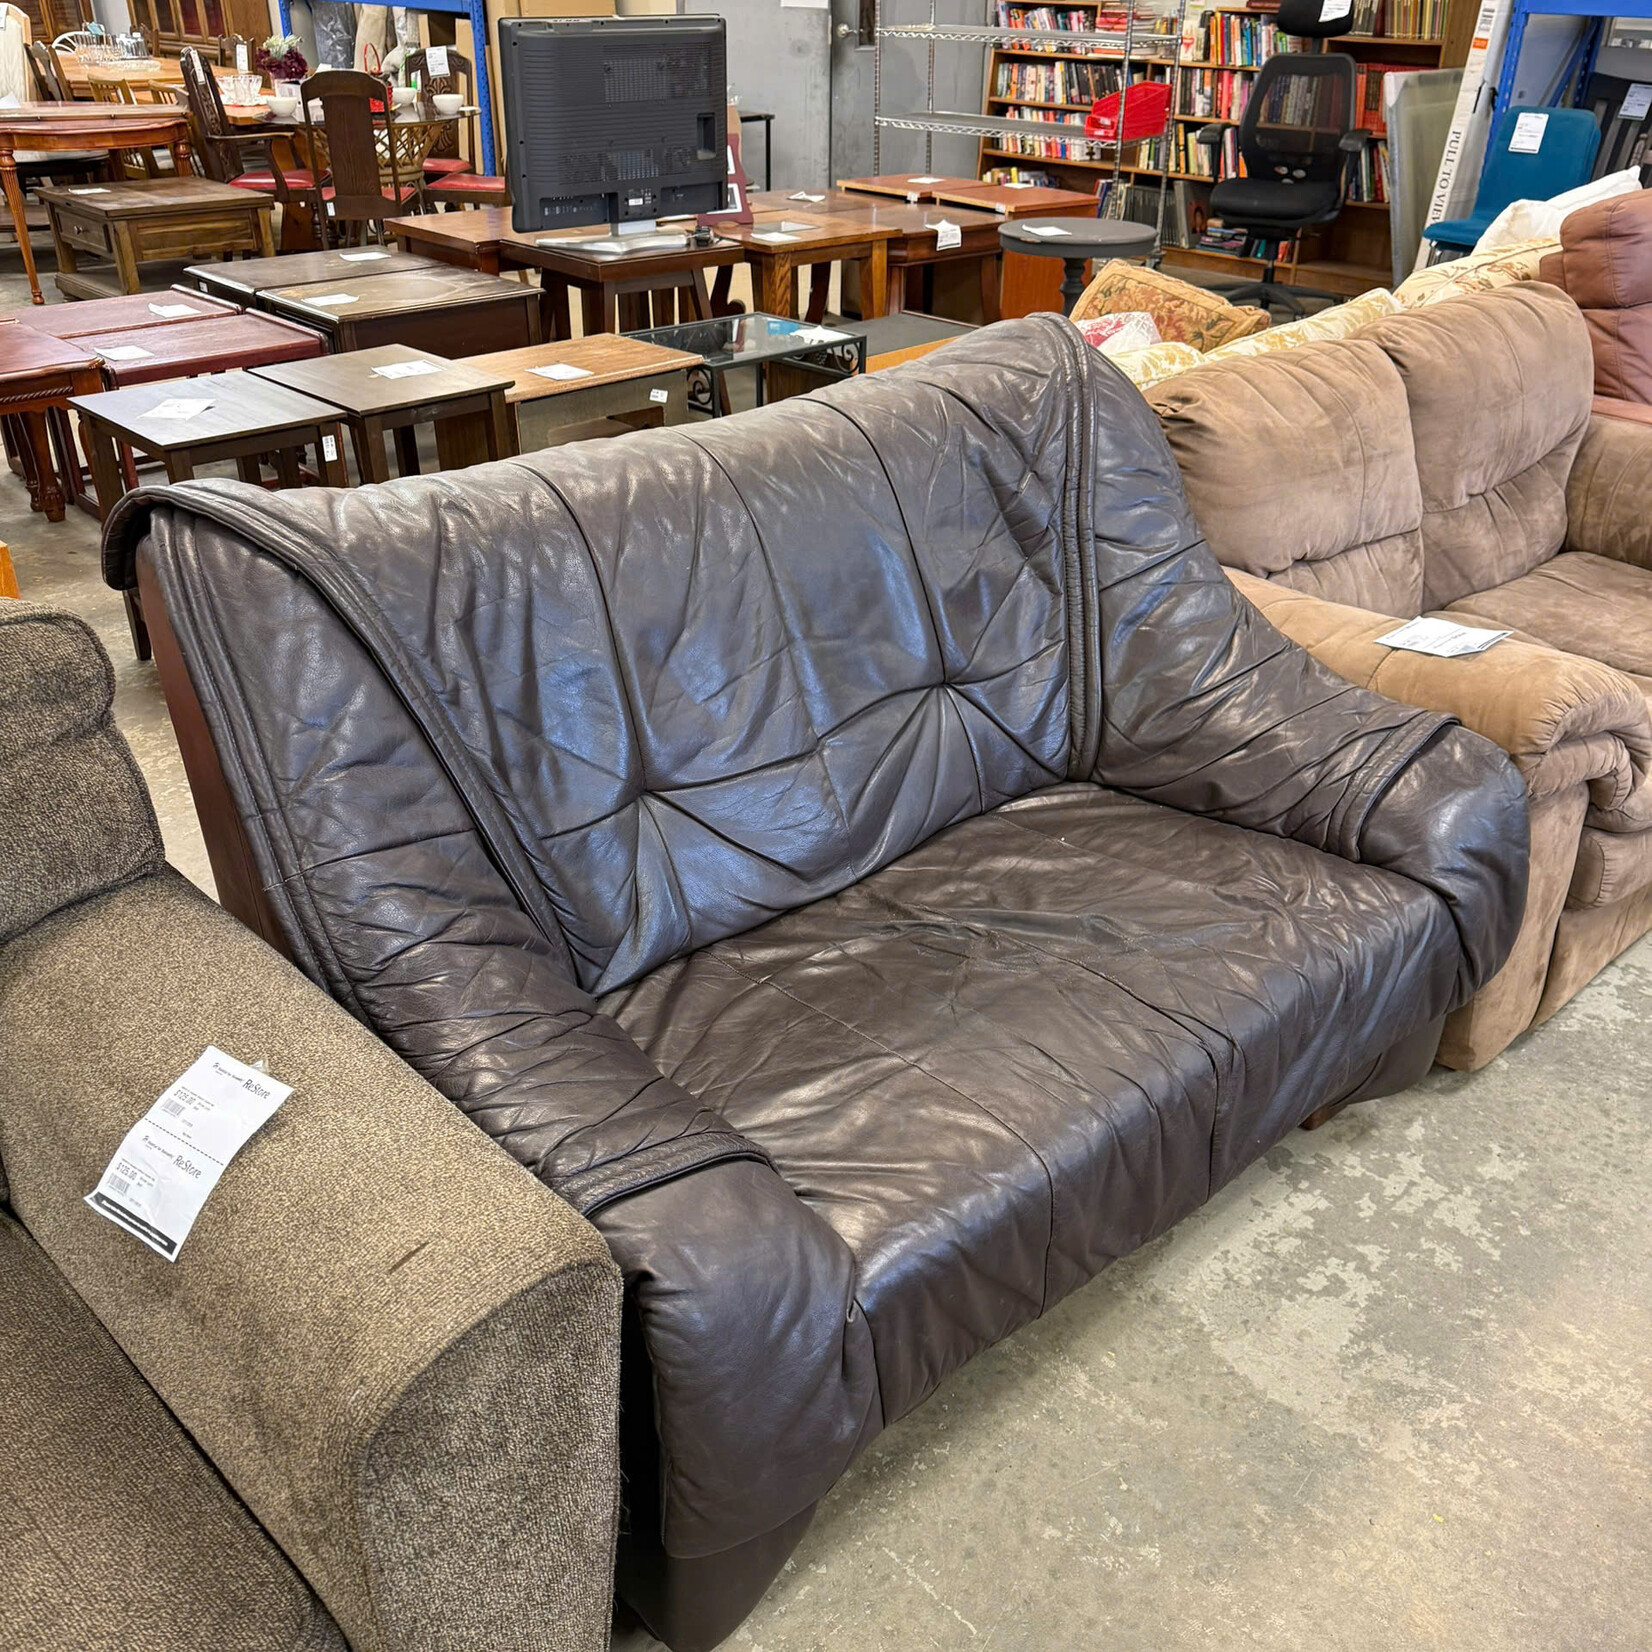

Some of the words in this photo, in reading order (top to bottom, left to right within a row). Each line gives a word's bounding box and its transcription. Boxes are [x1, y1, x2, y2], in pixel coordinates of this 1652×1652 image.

[1444, 130, 1461, 165] PULL
[1439, 169, 1452, 189] TO
[242, 1078, 271, 1100] ReStore
[173, 1154, 202, 1179] ReStore
